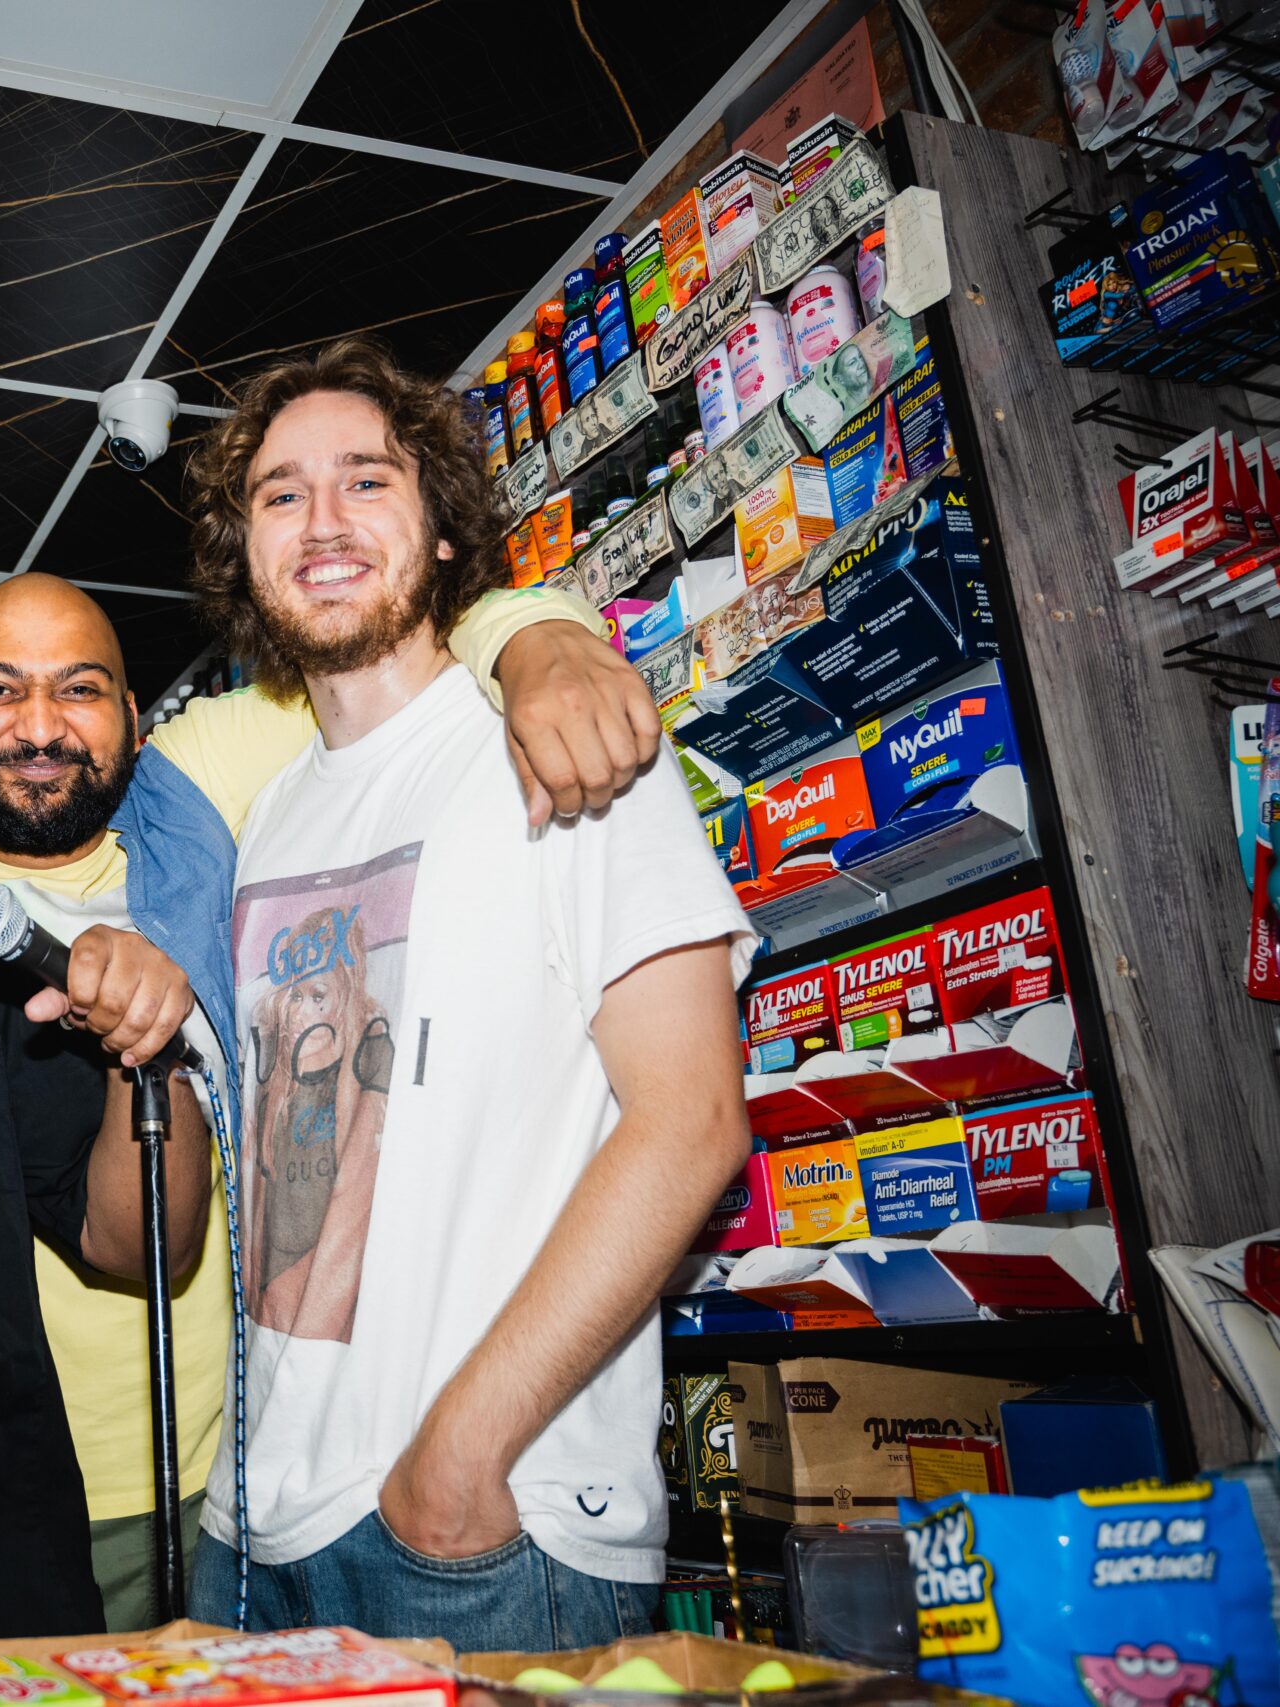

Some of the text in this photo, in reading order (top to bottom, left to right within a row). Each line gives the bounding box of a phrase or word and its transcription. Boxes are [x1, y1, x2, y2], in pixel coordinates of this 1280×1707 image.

[788, 126, 833, 162] Robitussin
[702, 162, 743, 197] Robitussin
[708, 176, 745, 209] Honey
[666, 215, 697, 248] Motrin
[1132, 199, 1219, 261] TROJAN
[623, 234, 657, 268] Robitussin
[1148, 224, 1222, 275] Pleasure Pack
[1054, 257, 1093, 292] ROUGH
[656, 308, 669, 322] DM
[1057, 304, 1098, 334] STUDDED
[562, 321, 588, 351] NyQuil
[796, 315, 835, 346] Johnson's
[731, 353, 760, 383] Johnson's
[701, 388, 724, 410] ohnson's
[787, 371, 815, 399] 20000
[901, 384, 941, 418] COLD RELIEF
[831, 436, 873, 468] COLD RELIEF
[746, 489, 778, 517] Vitamin C
[748, 488, 765, 506] 1000
[1142, 463, 1209, 514] Orajel
[1140, 512, 1160, 535] 3X
[860, 726, 877, 742] MAX
[889, 707, 964, 764] NyQuil
[910, 753, 948, 779] SEVERE
[912, 765, 950, 788] COLD FLU
[766, 773, 837, 826] DayQuil
[786, 815, 817, 842] SEVERE
[786, 827, 818, 847] COLD FLU
[955, 867, 978, 885] PACKETS
[267, 903, 361, 987] Gas-X
[938, 909, 1046, 967] TYLENOL
[1252, 917, 1270, 982] Colgate
[834, 945, 927, 997] TYLENOL
[945, 960, 980, 979] Acetaminophen
[947, 966, 1009, 991] Extra Strength
[748, 977, 825, 1024] TYLENOL
[839, 978, 903, 1007] SINUS SEVERE
[791, 1003, 825, 1022] SEVERE
[840, 1001, 873, 1018] Acetaminophen
[250, 1016, 431, 1093] UCCI
[293, 1102, 337, 1149] Gas
[966, 1115, 1086, 1162] TYLENOL
[783, 1157, 854, 1189] Motrin IB
[871, 1169, 900, 1181] Diamode
[984, 1154, 1013, 1177] PM
[874, 1172, 955, 1200] Anti-Diarrheal
[976, 1177, 1011, 1191] Acetaminophen
[876, 1203, 905, 1213] Loperamide
[898, 1210, 909, 1218] USP
[929, 1191, 958, 1208] Relief
[707, 1216, 748, 1235] ALLERGY
[686, 1377, 720, 1417] ORGANIC HEMP
[789, 1394, 828, 1408] CONE
[794, 1387, 826, 1395] PER PACK
[1096, 1518, 1206, 1550] KEEP ON
[1094, 1551, 1217, 1587] SUCKING!
[915, 1563, 984, 1606] cher
